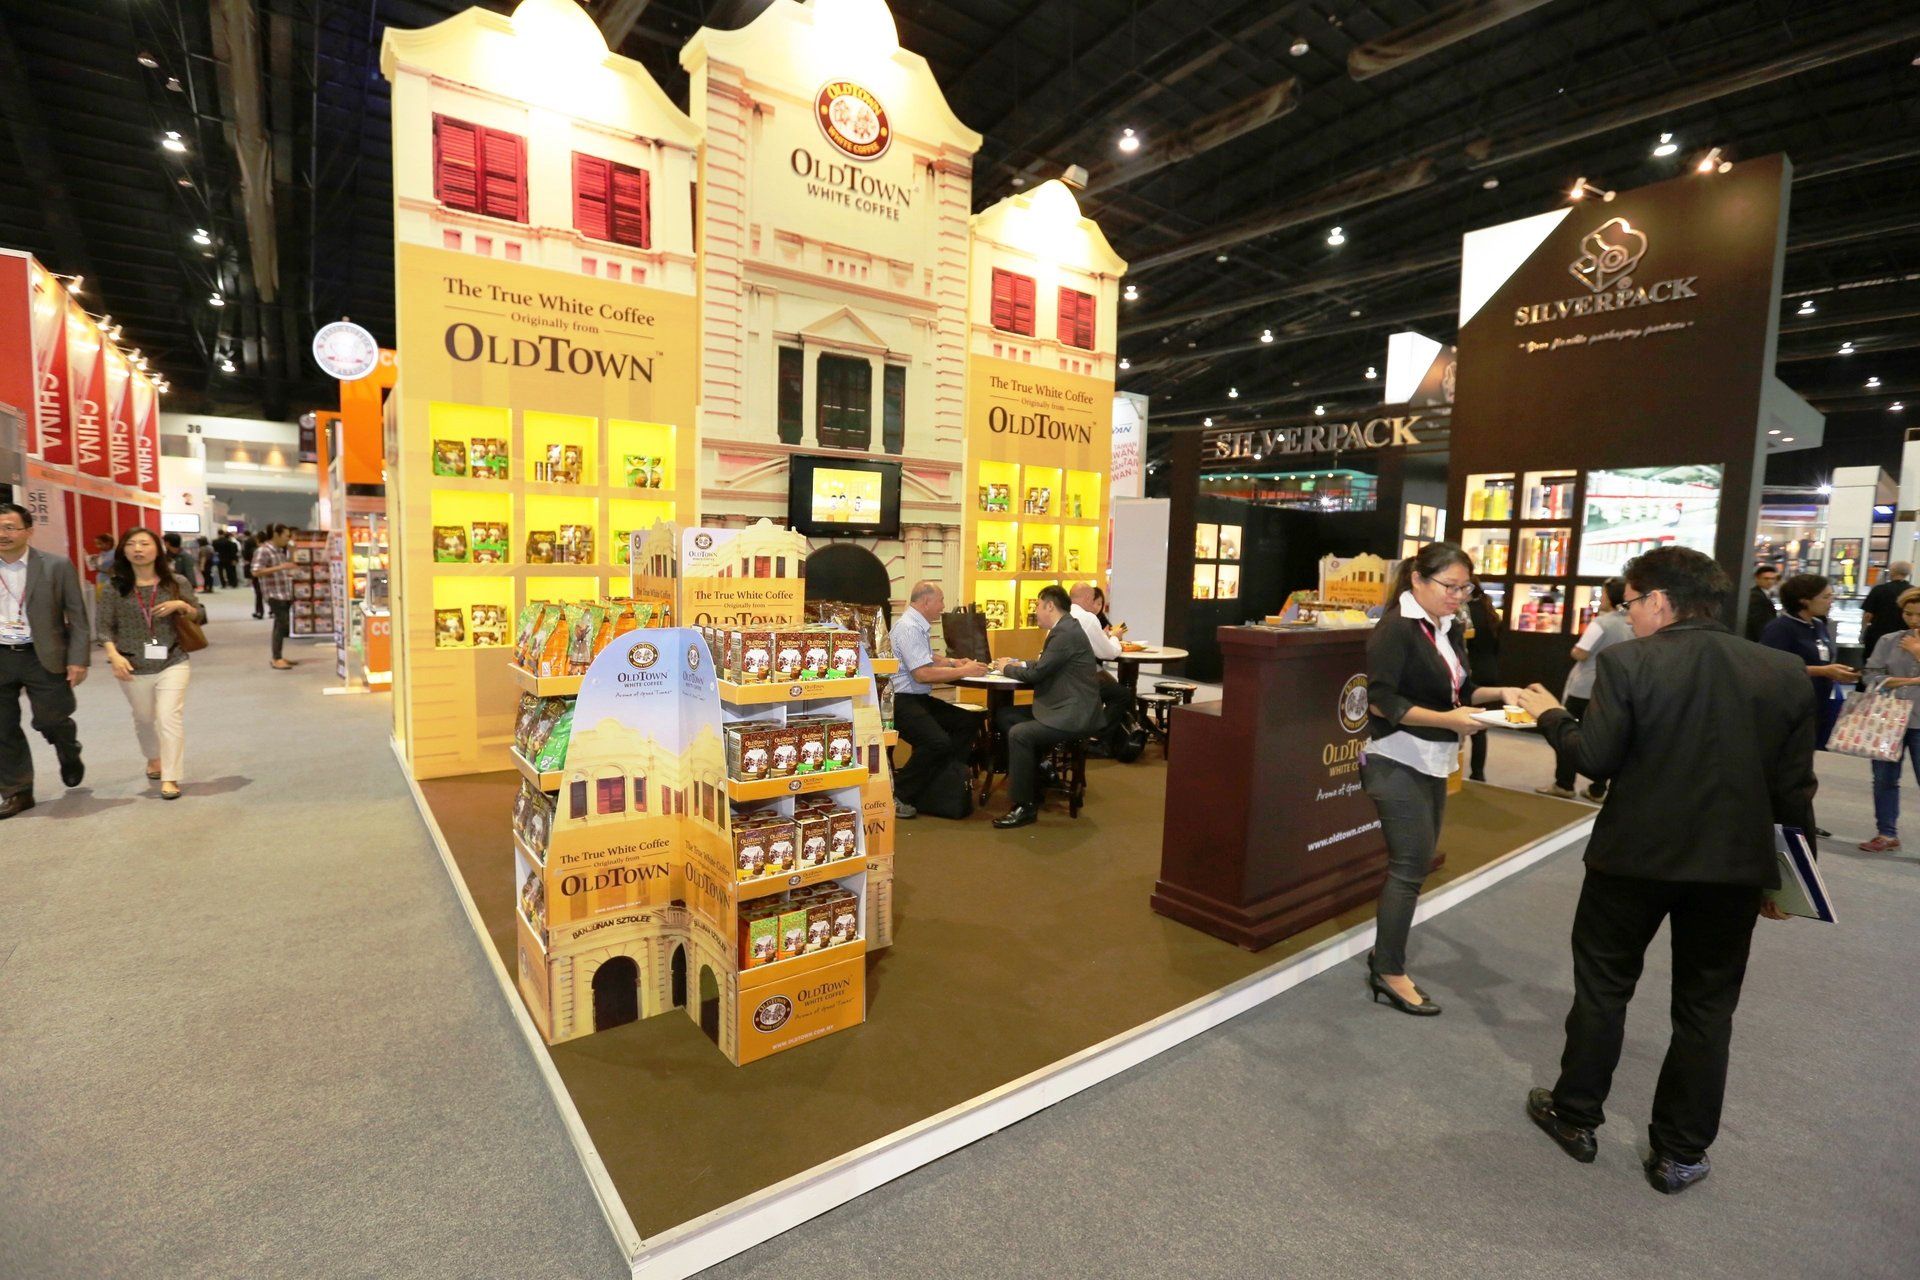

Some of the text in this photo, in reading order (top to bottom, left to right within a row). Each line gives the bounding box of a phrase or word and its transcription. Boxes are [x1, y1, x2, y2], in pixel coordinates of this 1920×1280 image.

[790, 147, 911, 208] OLDTOWN
[807, 182, 900, 221] WHITE COFFEE
[443, 276, 655, 327] The True White Coffee
[1513, 275, 1699, 327] SILVERPACK
[510, 311, 600, 335] Originally from
[444, 322, 655, 383] OLDTOWN
[989, 375, 1094, 405] The True White Coffee
[39, 373, 63, 449] CHINA
[988, 406, 1092, 445] OLDTOWN
[77, 399, 102, 464] CHINA
[111, 420, 131, 476] CHINA
[1215, 415, 1423, 458] SILVERPACK
[137, 435, 153, 484] CHINA
[695, 590, 794, 600] The True White Coffee
[617, 671, 668, 683] OLDTOWN
[1329, 763, 1351, 777] WHITE
[864, 800, 886, 811] Coffee
[560, 838, 670, 865] The True White Coffee
[594, 855, 640, 868] Originally from
[561, 862, 671, 897] OLDTOWN
[798, 979, 851, 1002] OLDTOWN
[804, 990, 845, 1007] WHITE COFFEE
